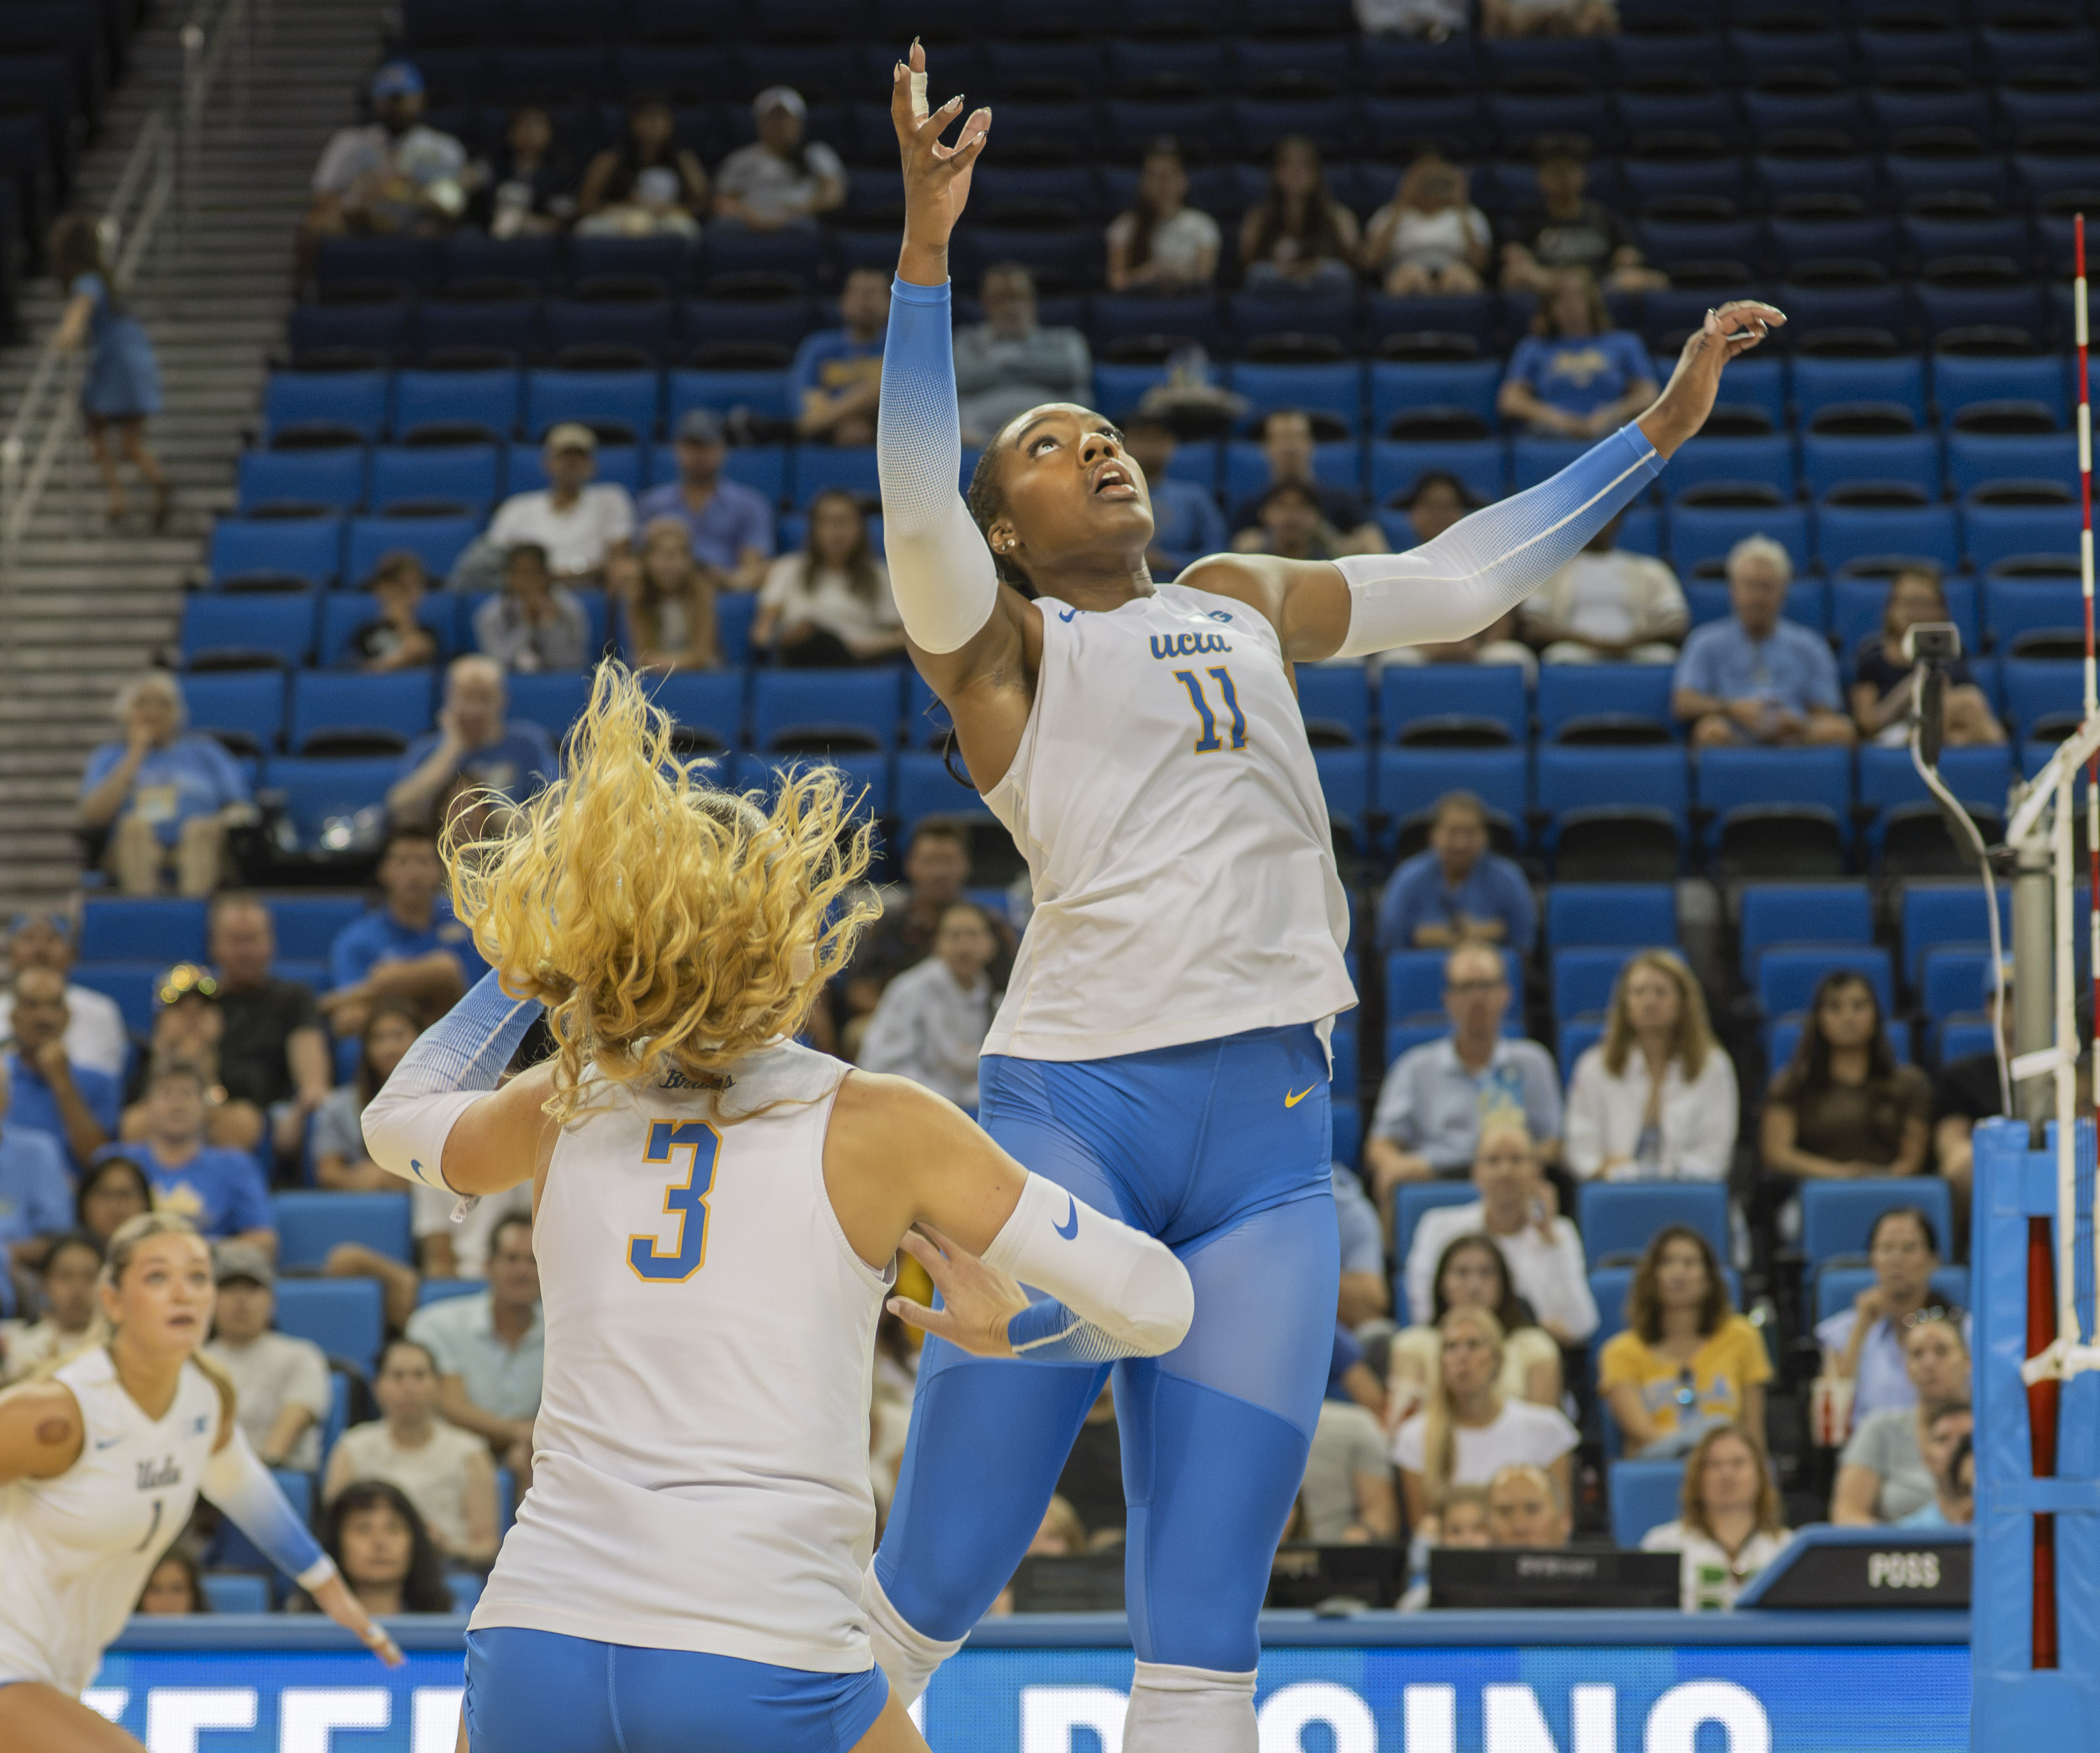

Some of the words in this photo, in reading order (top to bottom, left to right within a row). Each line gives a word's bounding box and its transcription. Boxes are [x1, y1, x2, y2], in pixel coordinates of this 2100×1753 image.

[1171, 665, 1248, 755] 11
[626, 1119, 723, 1283] 3
[1868, 1552, 1940, 1589] POSS
